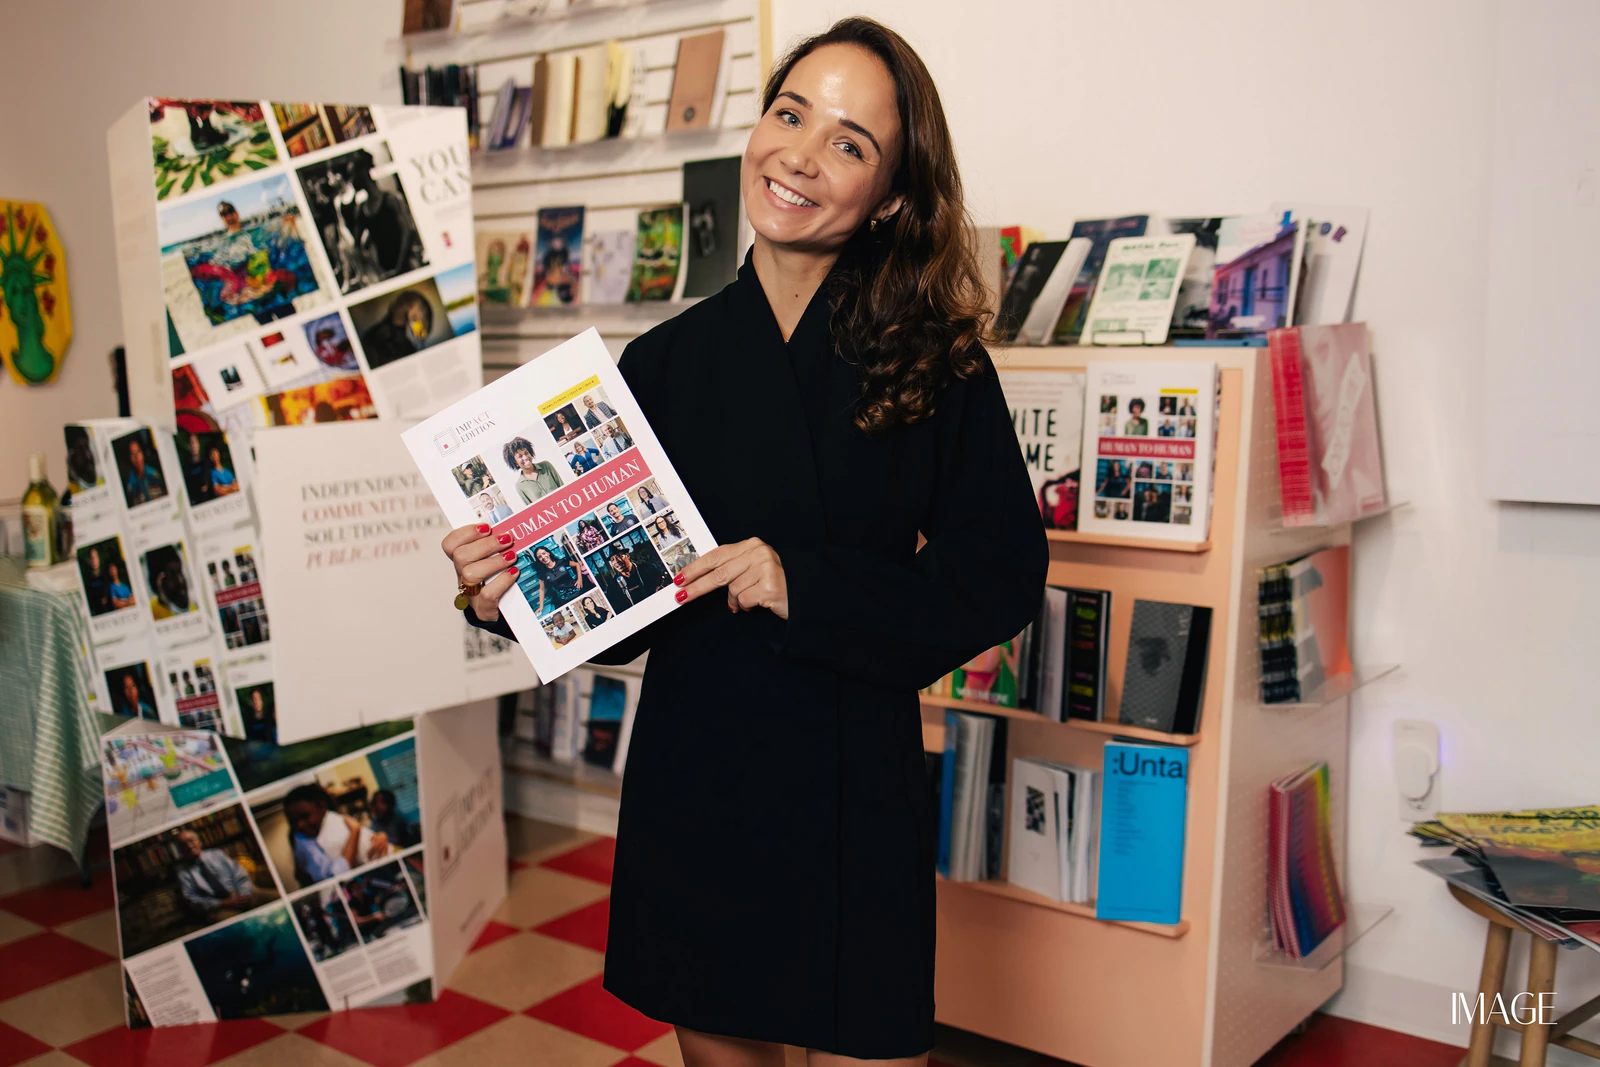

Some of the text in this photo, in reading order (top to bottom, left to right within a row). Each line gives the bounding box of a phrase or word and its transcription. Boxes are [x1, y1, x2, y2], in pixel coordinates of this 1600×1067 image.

[455, 411, 490, 435] IMPACT
[460, 420, 496, 443] EDITION
[301, 473, 419, 501] INDEPENDENT
[505, 459, 641, 540] UMAN TO HUMAN
[302, 496, 407, 523] COMMUNITY
[306, 539, 420, 569] PUBLICATION
